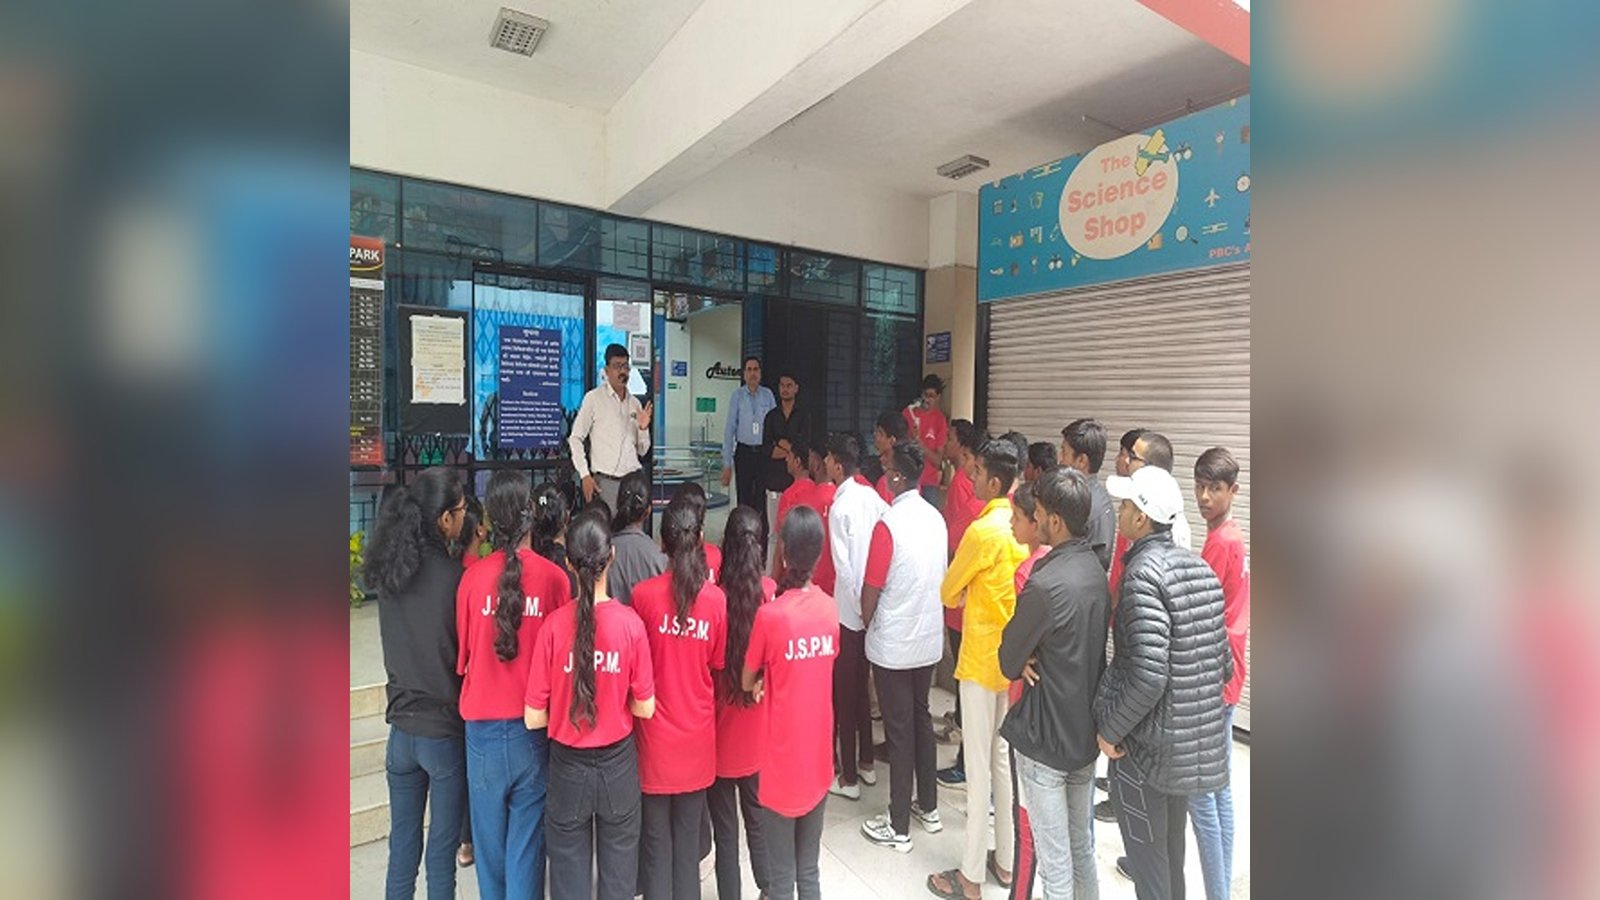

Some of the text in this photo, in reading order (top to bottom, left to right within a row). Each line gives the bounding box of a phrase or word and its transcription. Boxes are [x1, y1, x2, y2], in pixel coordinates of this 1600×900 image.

[1100, 155, 1131, 174] The
[1067, 170, 1168, 214] Science
[1084, 211, 1147, 241] Shop
[350, 247, 380, 262] PARK
[784, 635, 835, 661] J.S.P.M.
